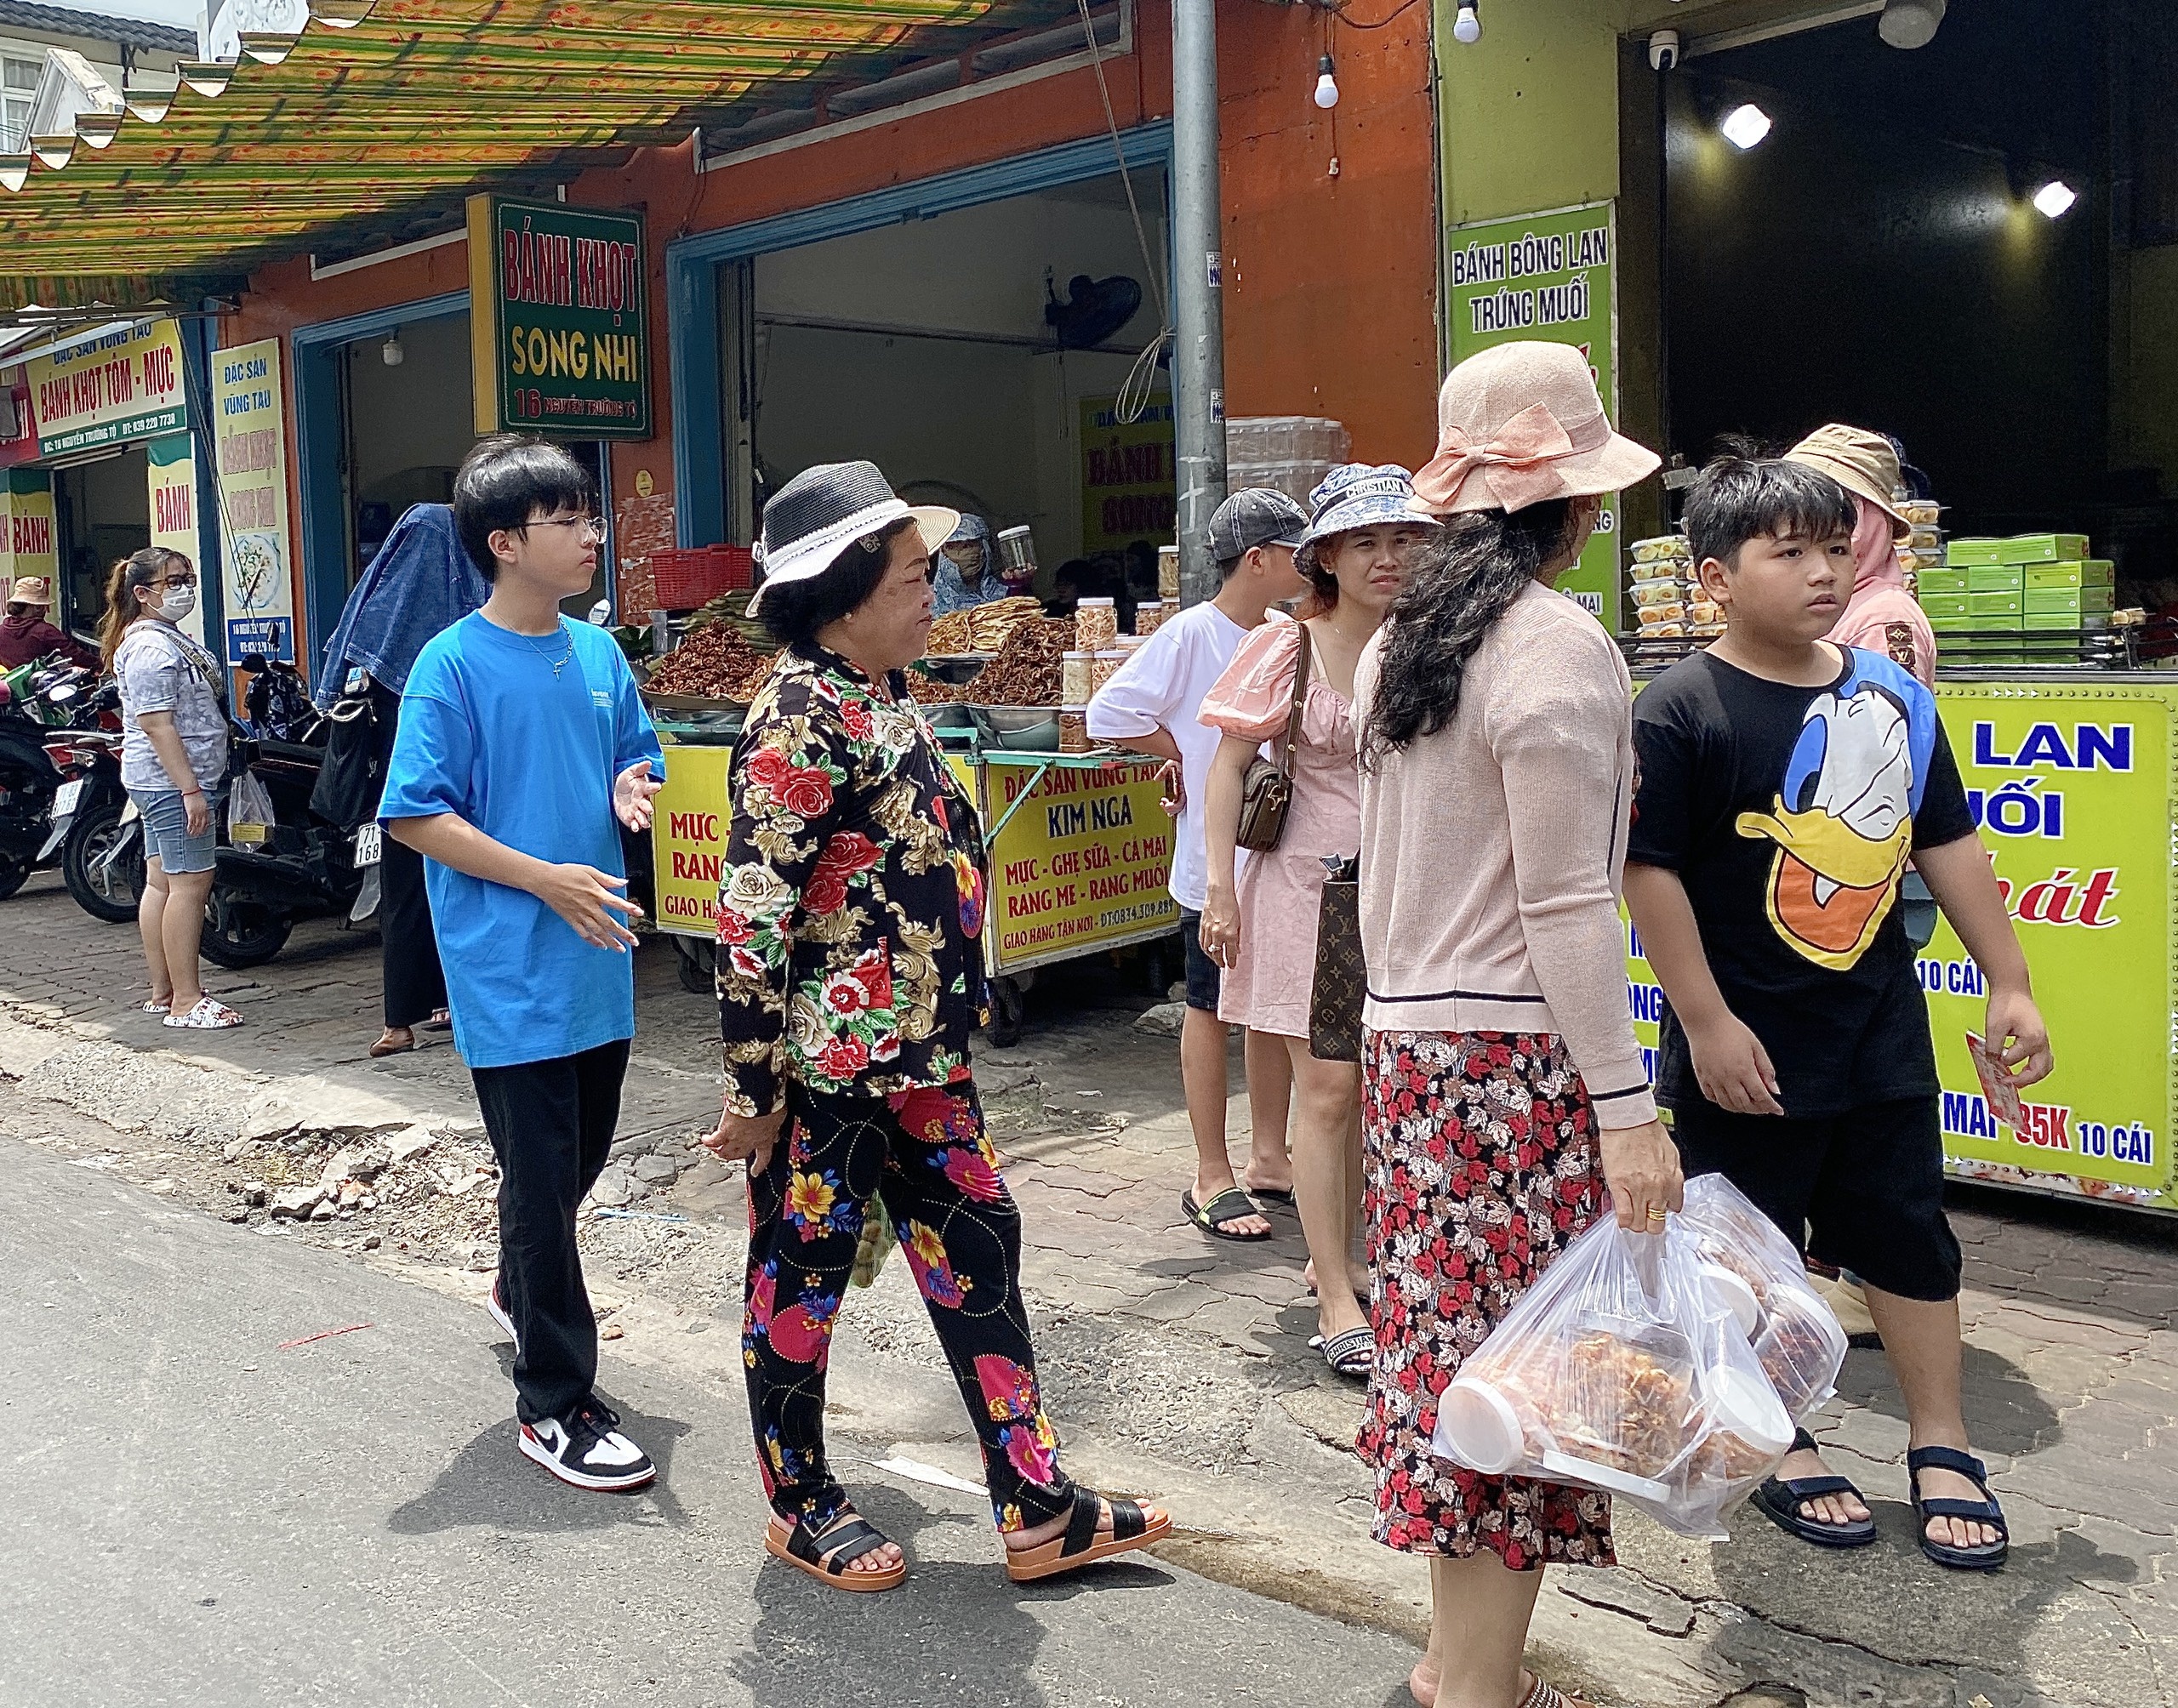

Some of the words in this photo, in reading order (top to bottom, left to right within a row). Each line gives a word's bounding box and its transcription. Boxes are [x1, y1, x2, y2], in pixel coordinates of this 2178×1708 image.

[505, 216, 572, 307] BÁNH
[576, 238, 636, 326] KHỌT
[1452, 241, 1505, 287] BÁNH
[1509, 232, 1563, 278] BÔNG
[1567, 227, 1608, 270] LAN
[1470, 287, 1534, 333] TRỨNG
[1538, 271, 1590, 325] MUỐI
[225, 362, 244, 386] ĐẶC
[246, 353, 267, 379] SẢN
[512, 326, 588, 379] SONG
[595, 333, 636, 382] NHI
[40, 372, 71, 424] BÁNH
[72, 366, 102, 420] KHỌT
[105, 352, 133, 406] TÔM
[143, 343, 174, 404] MỰC
[223, 393, 250, 416] VŨNG
[252, 387, 271, 410] TÀU
[515, 389, 541, 418] 16
[156, 477, 191, 532] BÁNH
[1346, 479, 1401, 498] CHRISTIAN
[13, 509, 50, 554] BÁNH
[1975, 723, 2131, 770] LAN
[670, 811, 719, 846] MỰC
[1046, 801, 1086, 839] KIM
[1091, 794, 1133, 832] NGA
[1968, 778, 2061, 836] ỐI
[672, 851, 724, 882] RAN
[1005, 858, 1039, 889] MỰC
[1051, 851, 1080, 878] GHẸ
[1083, 842, 1111, 871] SỮA
[1122, 836, 1141, 863] CÁ
[1142, 835, 1167, 861] MAI
[664, 895, 698, 917] GIAO
[1007, 888, 1052, 919] RANG
[1056, 884, 1077, 908] ME
[1089, 873, 1129, 902] RANG
[1132, 859, 1169, 892] MUỐI
[1003, 931, 1028, 950] GIAO
[1029, 923, 1055, 944] HÀNG
[1057, 918, 1075, 939] TẬN
[1077, 915, 1094, 933] NƠI
[1917, 960, 1941, 991] 10
[1948, 959, 1983, 995] CÁI
[2078, 1124, 2105, 1157] 10
[2113, 1124, 2152, 1164] CÁI
[1328, 1335, 1375, 1360] CHRISTIAN
